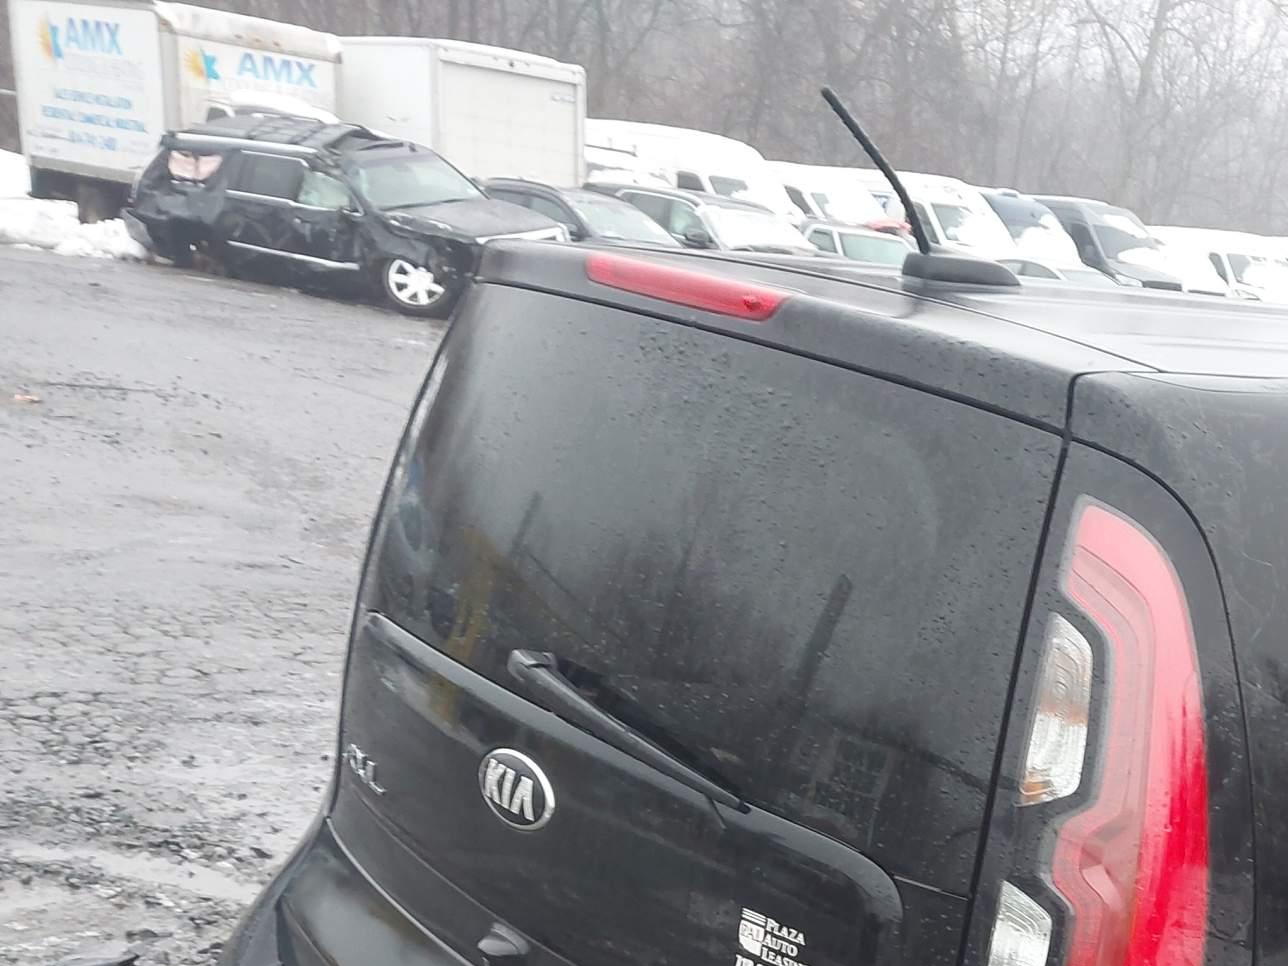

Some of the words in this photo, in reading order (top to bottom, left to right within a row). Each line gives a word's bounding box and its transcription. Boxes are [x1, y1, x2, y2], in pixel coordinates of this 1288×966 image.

[65, 17, 124, 56] AMX
[238, 52, 317, 88] AMX
[485, 758, 535, 821] KIA
[762, 933, 798, 957] AUTO
[765, 917, 806, 946] PLAZA
